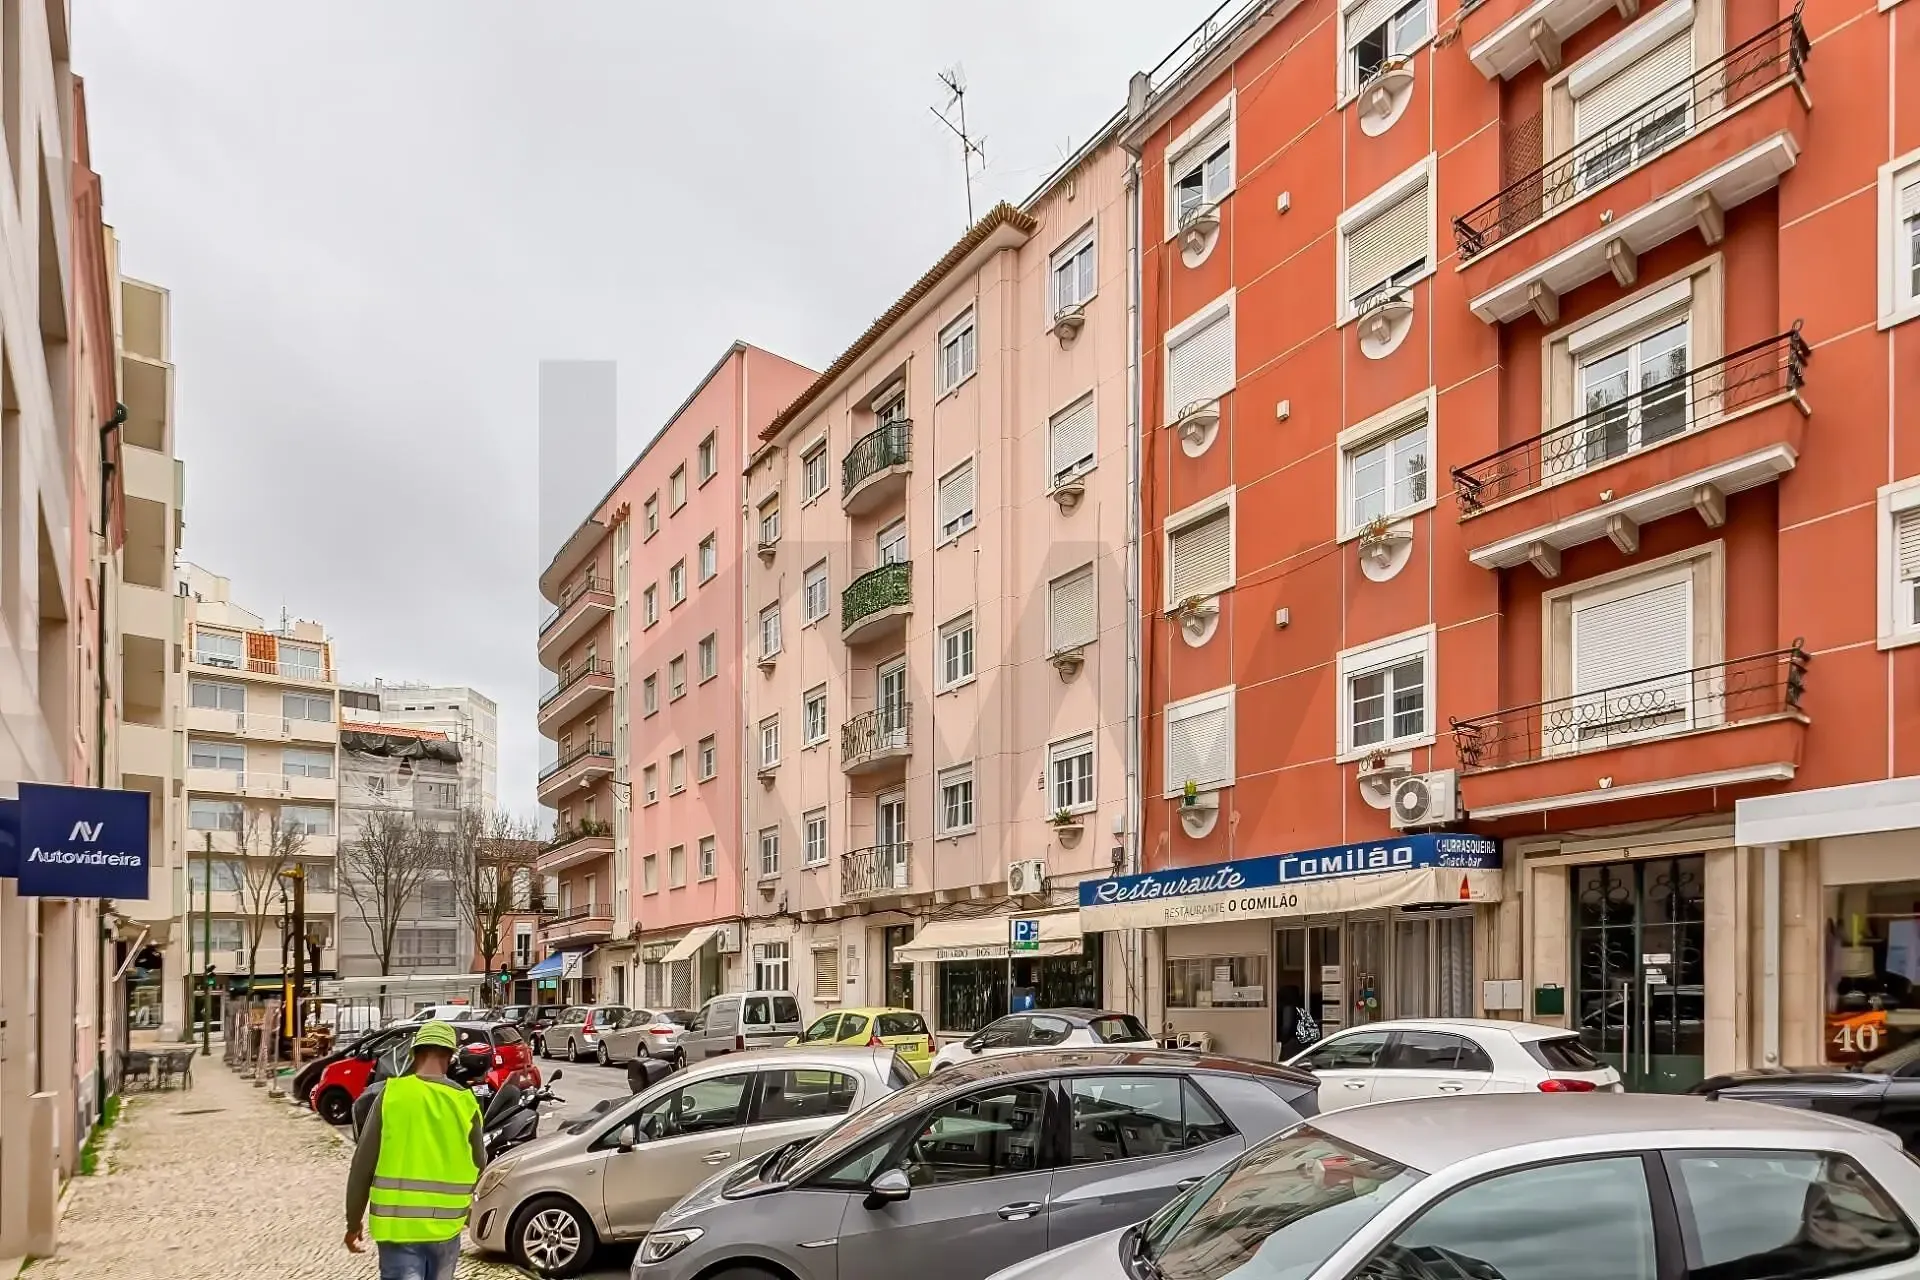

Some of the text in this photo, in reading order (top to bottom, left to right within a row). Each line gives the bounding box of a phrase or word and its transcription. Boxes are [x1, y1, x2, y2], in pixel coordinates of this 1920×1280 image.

[1436, 839, 1496, 854] CHURRASQUEIRA
[27, 847, 142, 867] Autovidreira
[1438, 853, 1483, 868] Snack-bar
[1164, 902, 1225, 920] RESTAURANTE
[1228, 899, 1237, 912] O
[1240, 893, 1298, 912] COMILÃO
[1016, 921, 1029, 942] P
[1832, 1024, 1879, 1053] 40
